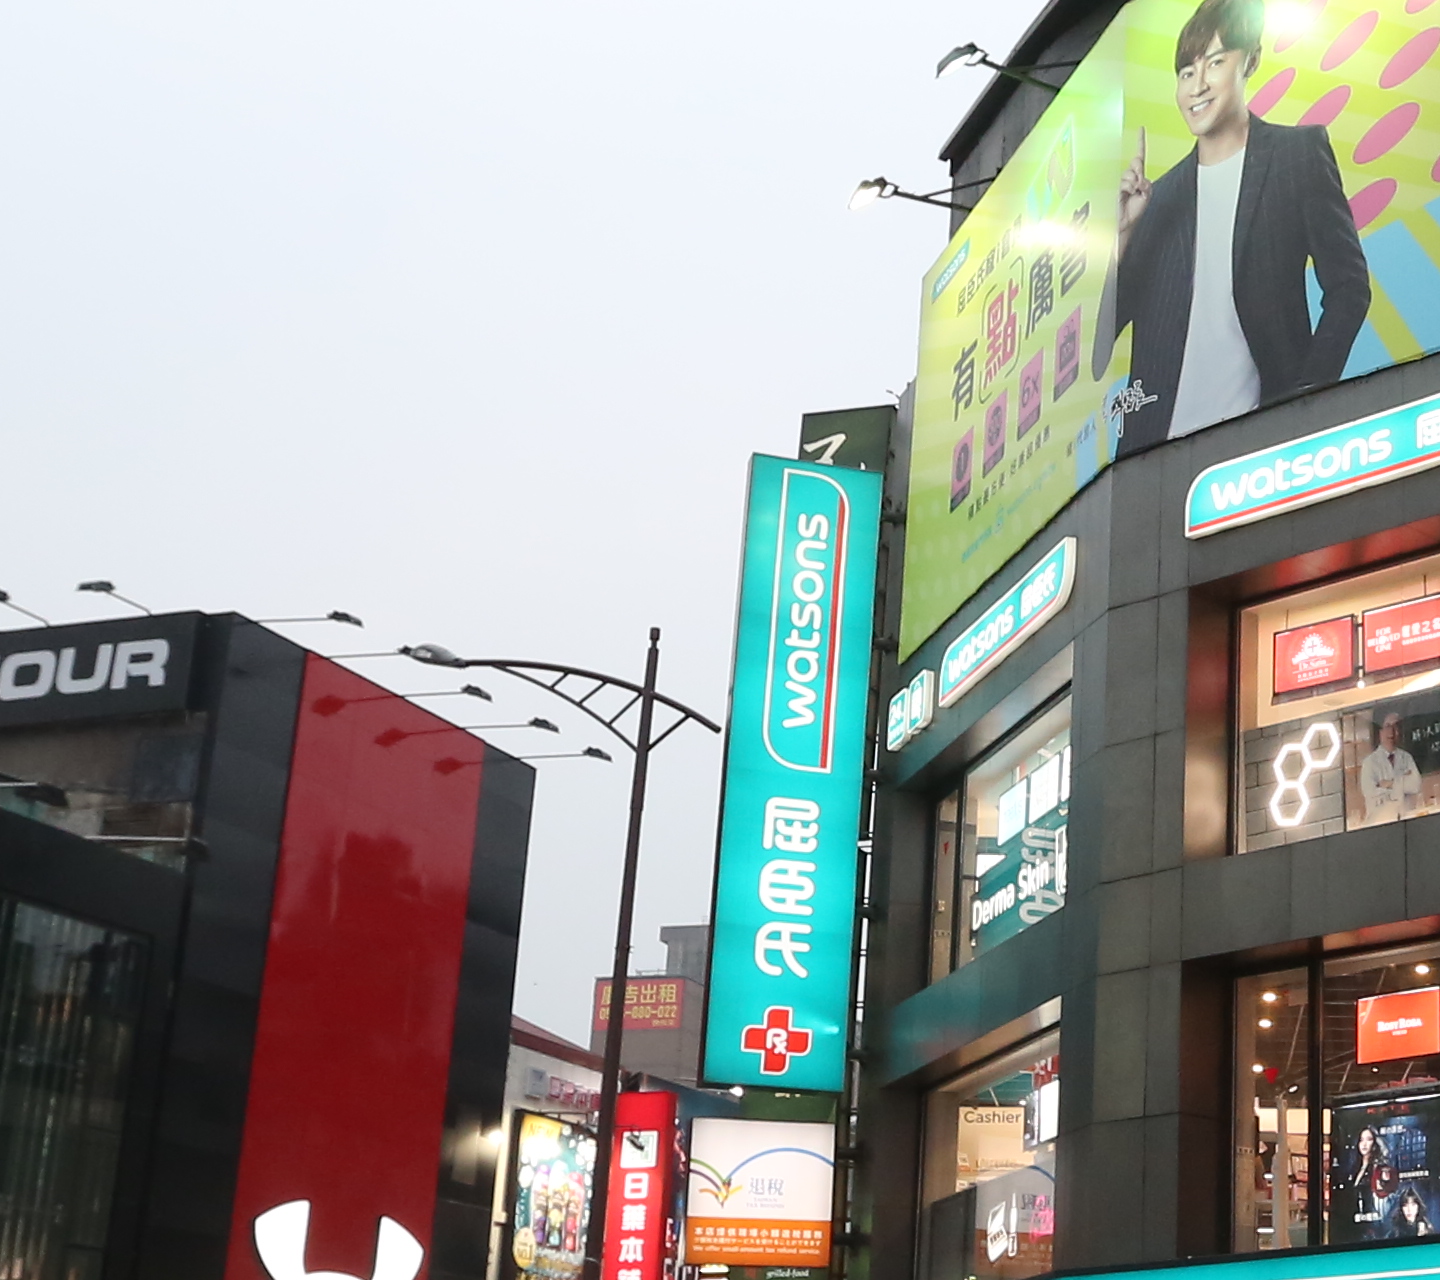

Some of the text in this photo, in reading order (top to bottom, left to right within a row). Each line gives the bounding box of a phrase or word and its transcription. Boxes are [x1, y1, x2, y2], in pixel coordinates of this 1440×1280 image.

[1210, 426, 1392, 512] watsons
[783, 513, 829, 730] watsons
[948, 561, 1057, 683] watsons 屈臣氏
[754, 796, 820, 979] 屈臣氏
[971, 858, 1050, 932] Derma Skin
[963, 1110, 1022, 1124] Cashier
[748, 1177, 785, 1197] 退稅
